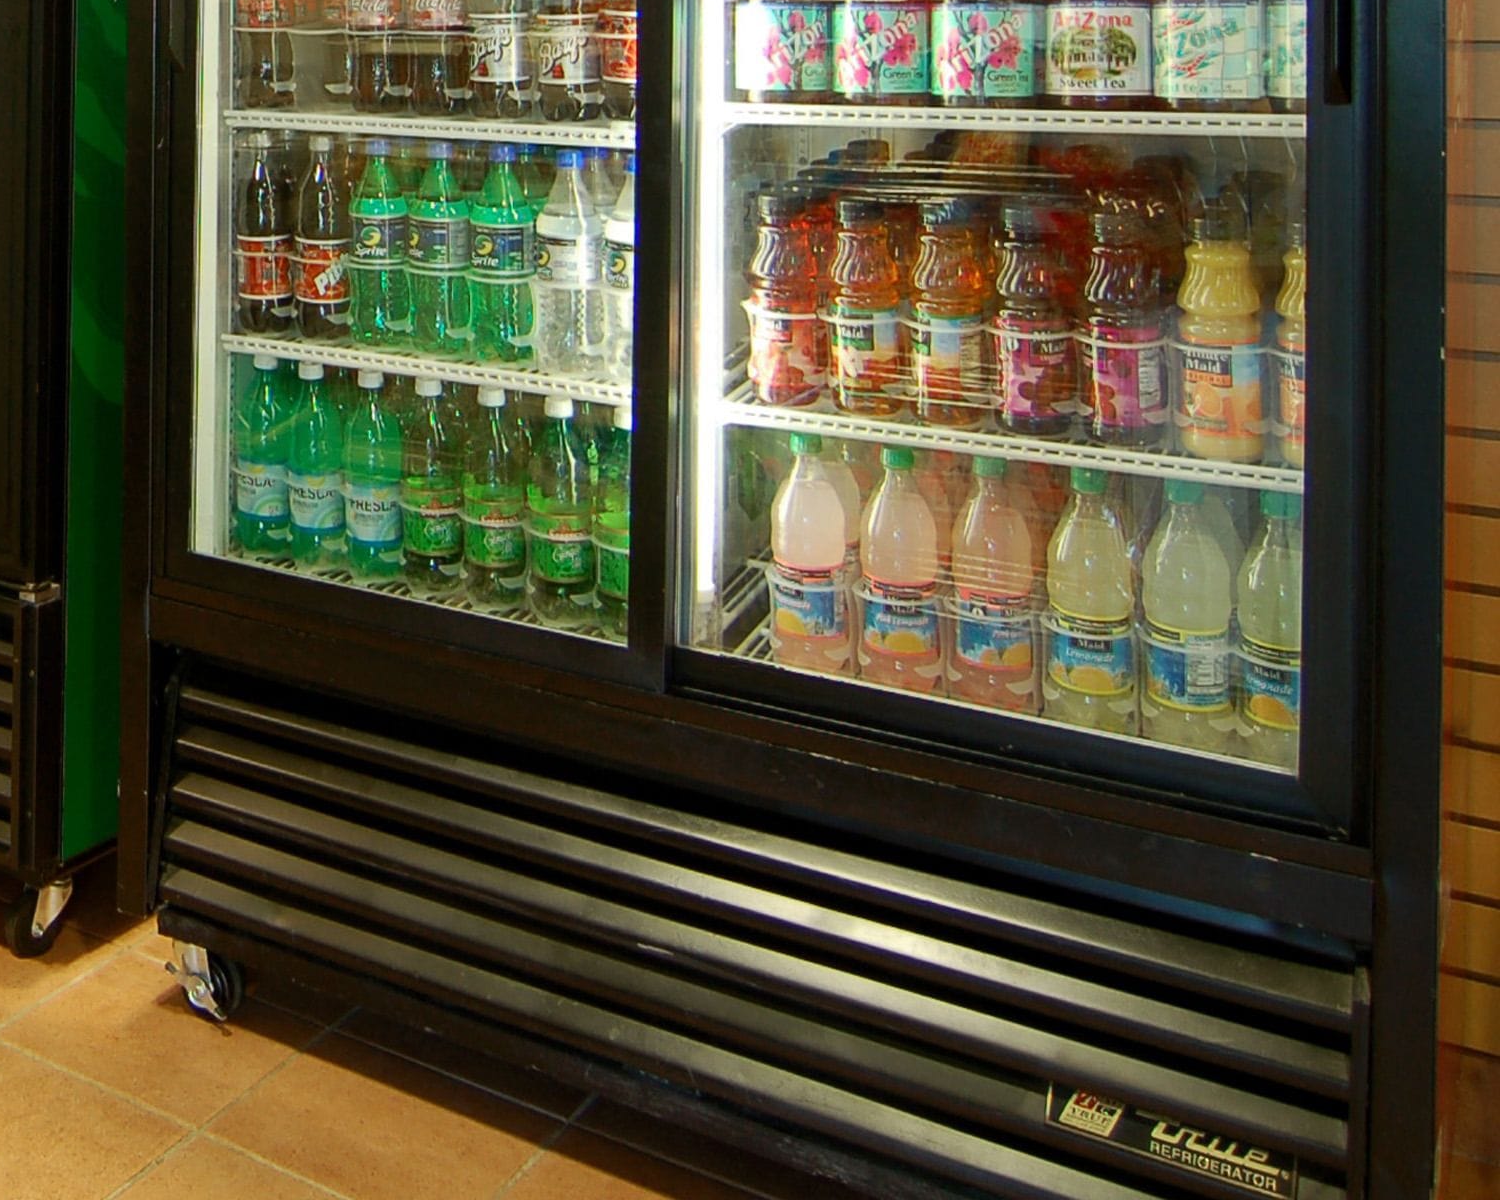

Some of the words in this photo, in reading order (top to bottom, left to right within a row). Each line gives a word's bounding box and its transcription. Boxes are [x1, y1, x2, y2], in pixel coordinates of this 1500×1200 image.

[1053, 10, 1133, 32] AriZona
[882, 67, 913, 81] Green
[988, 70, 1014, 83] Green
[1059, 76, 1098, 90] Sweet
[1102, 76, 1126, 89] Tea
[355, 242, 387, 258] Sprite
[471, 251, 500, 267] Sprite
[1185, 358, 1221, 374] Maid
[1066, 647, 1115, 664] Lemonade
[1149, 1139, 1278, 1191] REFRIGERATOR
